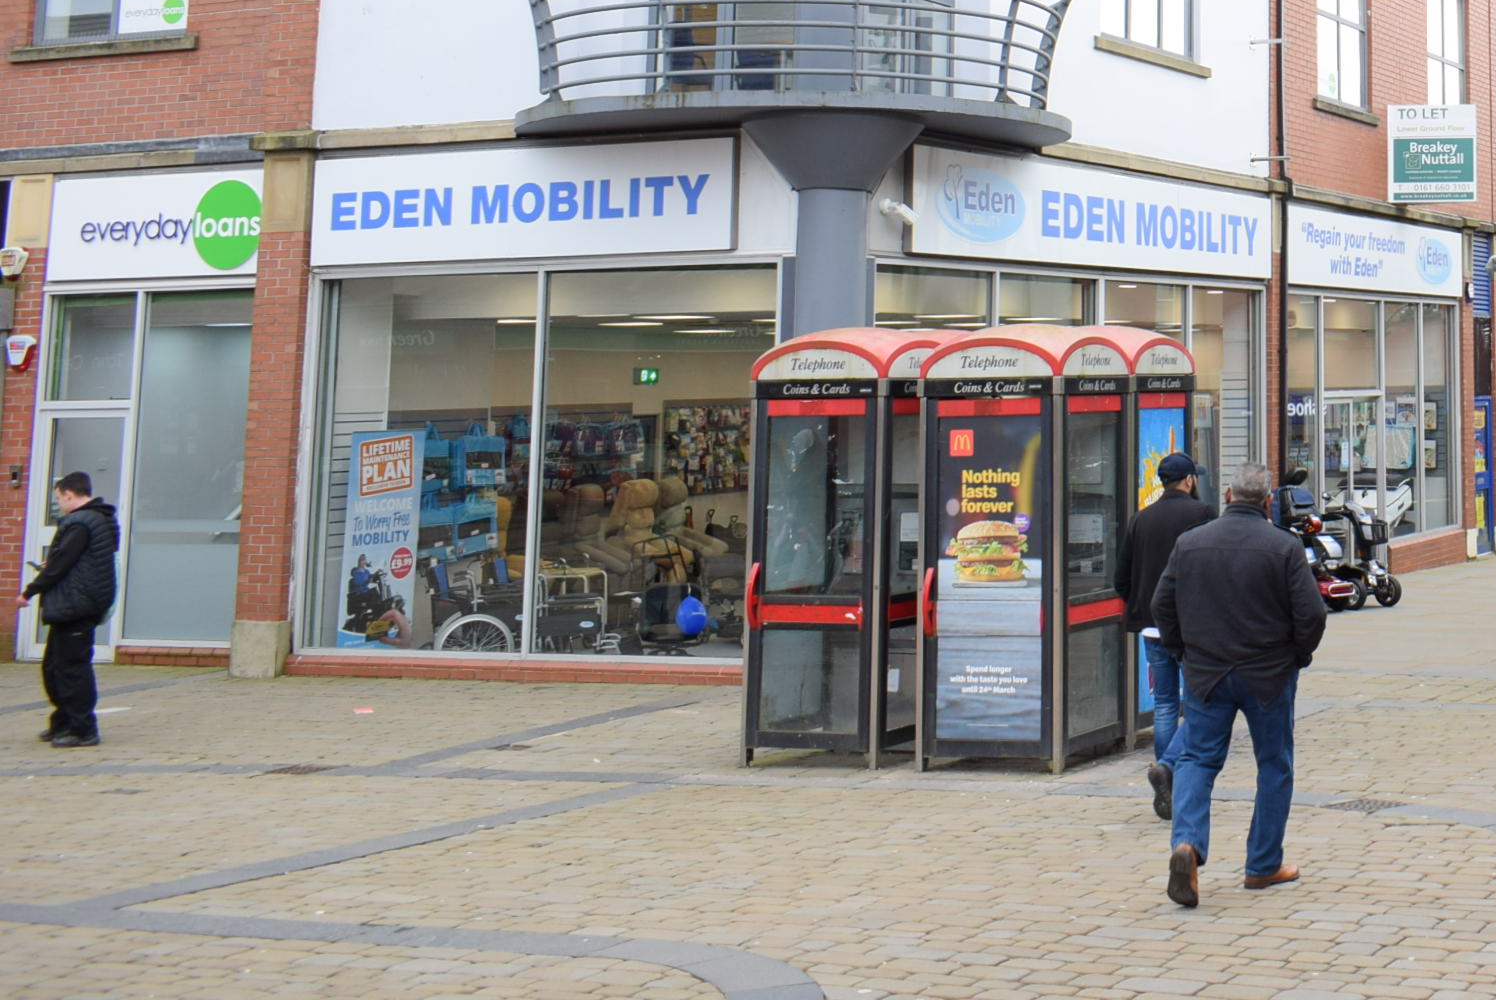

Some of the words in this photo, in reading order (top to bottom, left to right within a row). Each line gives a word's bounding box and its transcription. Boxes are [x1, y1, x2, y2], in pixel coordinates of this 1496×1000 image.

[1397, 108, 1417, 120] TO
[1422, 108, 1448, 120] LET
[1409, 141, 1458, 156] Breakey
[1421, 153, 1464, 165] Nuttall
[1413, 184, 1432, 192] 0161
[330, 187, 453, 232] EDEN
[471, 173, 711, 225] MOBILITY
[963, 179, 1016, 215] Eden
[1041, 189, 1125, 244] EDEN
[1136, 202, 1258, 257] MOBILITY
[1344, 232, 1367, 252] your
[1368, 232, 1406, 255] freedom
[1426, 246, 1448, 267] Eden
[1330, 255, 1352, 275] with
[791, 357, 846, 372] Telephone
[960, 355, 1019, 371] Telephone
[1081, 353, 1112, 369] Telephone
[1151, 353, 1178, 368] Telephone
[782, 383, 810, 395] Coins
[811, 383, 820, 395] &
[822, 383, 850, 395] Cards
[953, 382, 982, 393] Coins
[983, 381, 993, 393] &
[995, 381, 1025, 393] Cards
[1079, 379, 1094, 391] Coins
[1100, 379, 1117, 391] Cards
[363, 438, 411, 457] LIFETIME
[363, 459, 411, 485] PLAN
[961, 468, 1021, 487] Nothing
[961, 484, 997, 499] lasts
[354, 497, 413, 513] WELCOME
[961, 499, 1014, 513] forever
[353, 516, 363, 532] To
[365, 515, 392, 532] Worry
[393, 512, 410, 527] Free
[352, 530, 410, 547] MOBILITY
[965, 665, 988, 674] Spend
[989, 665, 1012, 675] longer
[950, 675, 966, 683] with
[966, 675, 979, 683] the
[998, 677, 1012, 685] you
[1012, 675, 1028, 683] love
[961, 686, 978, 694] until
[992, 686, 1016, 694] March
